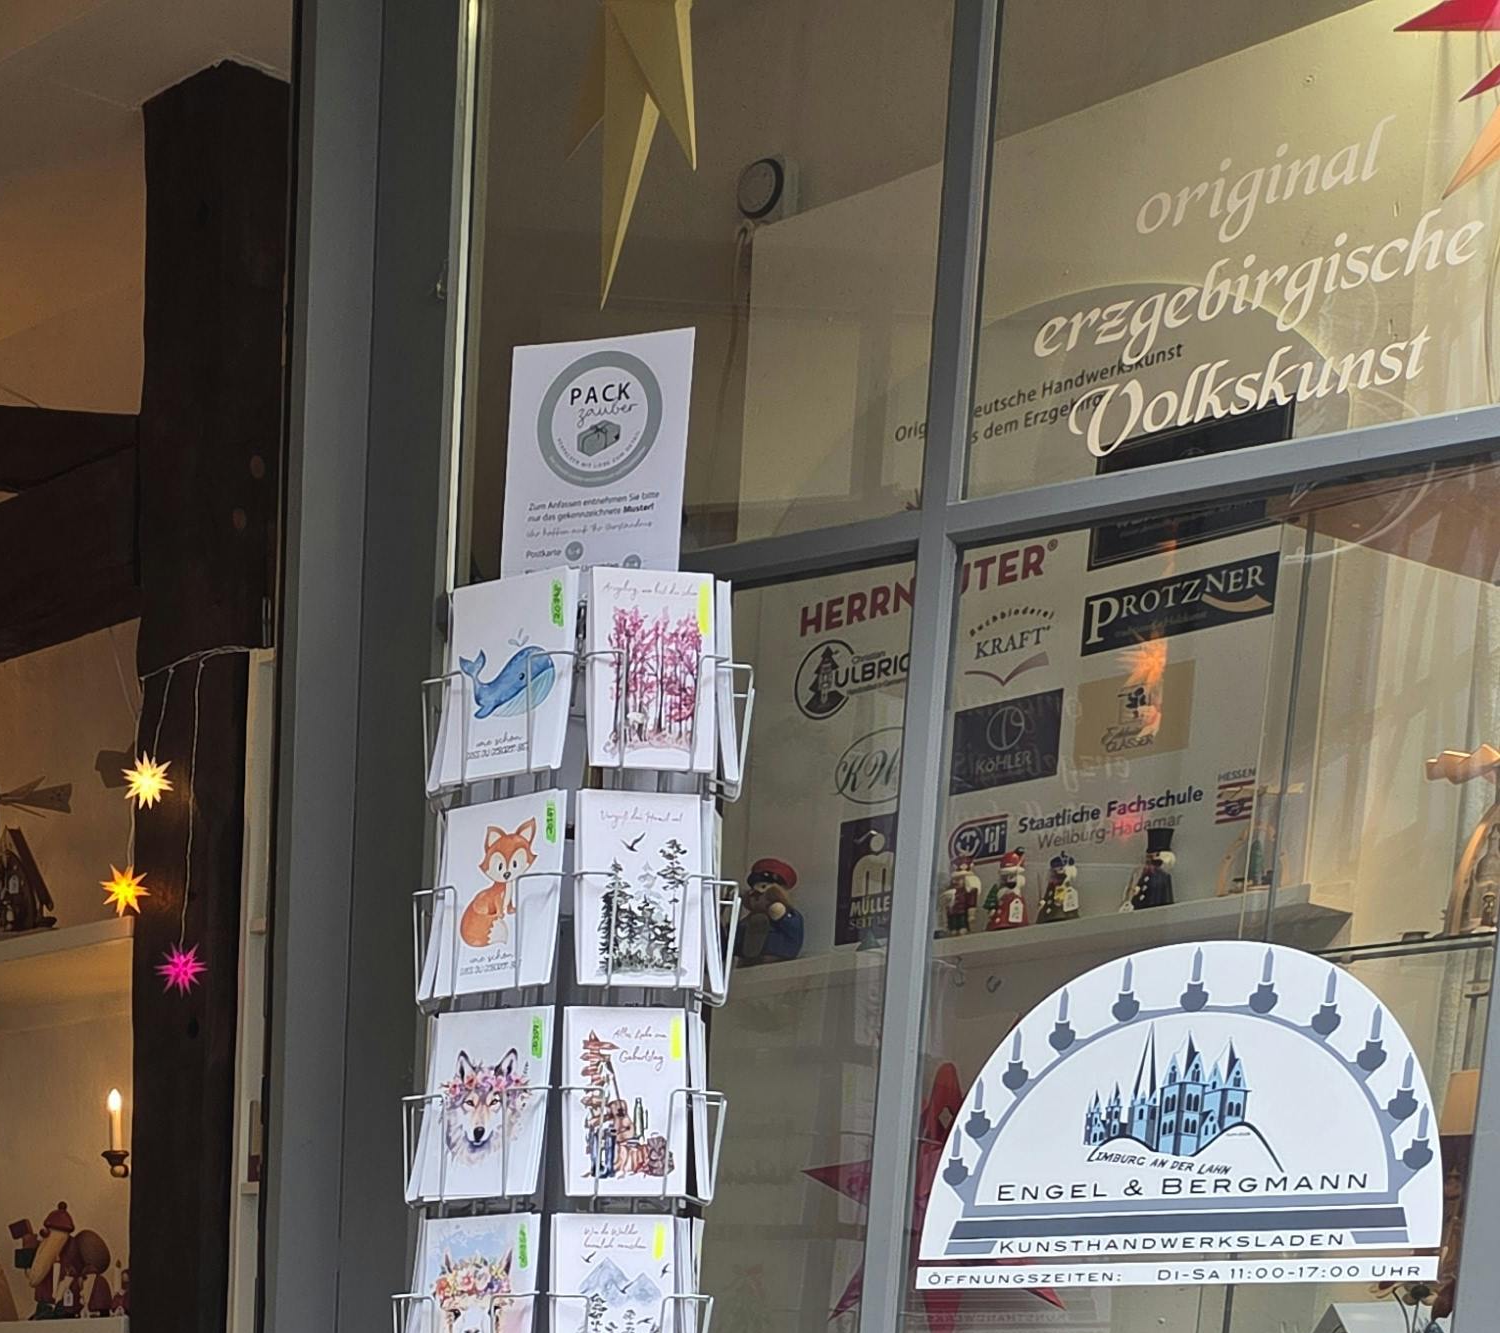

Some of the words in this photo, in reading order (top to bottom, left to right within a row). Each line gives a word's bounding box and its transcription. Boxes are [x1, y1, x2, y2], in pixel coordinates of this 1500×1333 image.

[1136, 114, 1396, 244] original
[1034, 209, 1484, 366] erzgebirgische
[569, 381, 631, 406] PACK
[973, 389, 1037, 418] eutsche
[1069, 328, 1431, 458] Volkskunst
[576, 401, 639, 428] zauber
[983, 415, 1019, 441] dem
[1023, 390, 1112, 428] Erzgebrg
[835, 653, 910, 688] ULBRIC
[1217, 768, 1257, 782] HESSEN
[1018, 805, 1101, 834] Staatliche
[1106, 785, 1204, 817] Fachschule
[1037, 813, 1183, 850] Weilburg-Hadamar
[849, 895, 891, 918] MÜLLE
[1150, 1157, 1168, 1169] AN
[1169, 1160, 1195, 1172] DER
[1197, 1161, 1232, 1176] LAHN
[997, 1183, 1107, 1202] ENGEL
[1123, 1179, 1144, 1196] &
[1161, 1173, 1368, 1195] BERGMANN
[999, 1233, 1344, 1254] KUNSTHANDWERKSLADEN
[928, 1271, 1122, 1285] ÖFFNUNGSZEITEN:
[1157, 1269, 1220, 1281] DI-SA
[1230, 1266, 1360, 1280] 11:00-17:00
[1371, 1264, 1420, 1277] UHR
